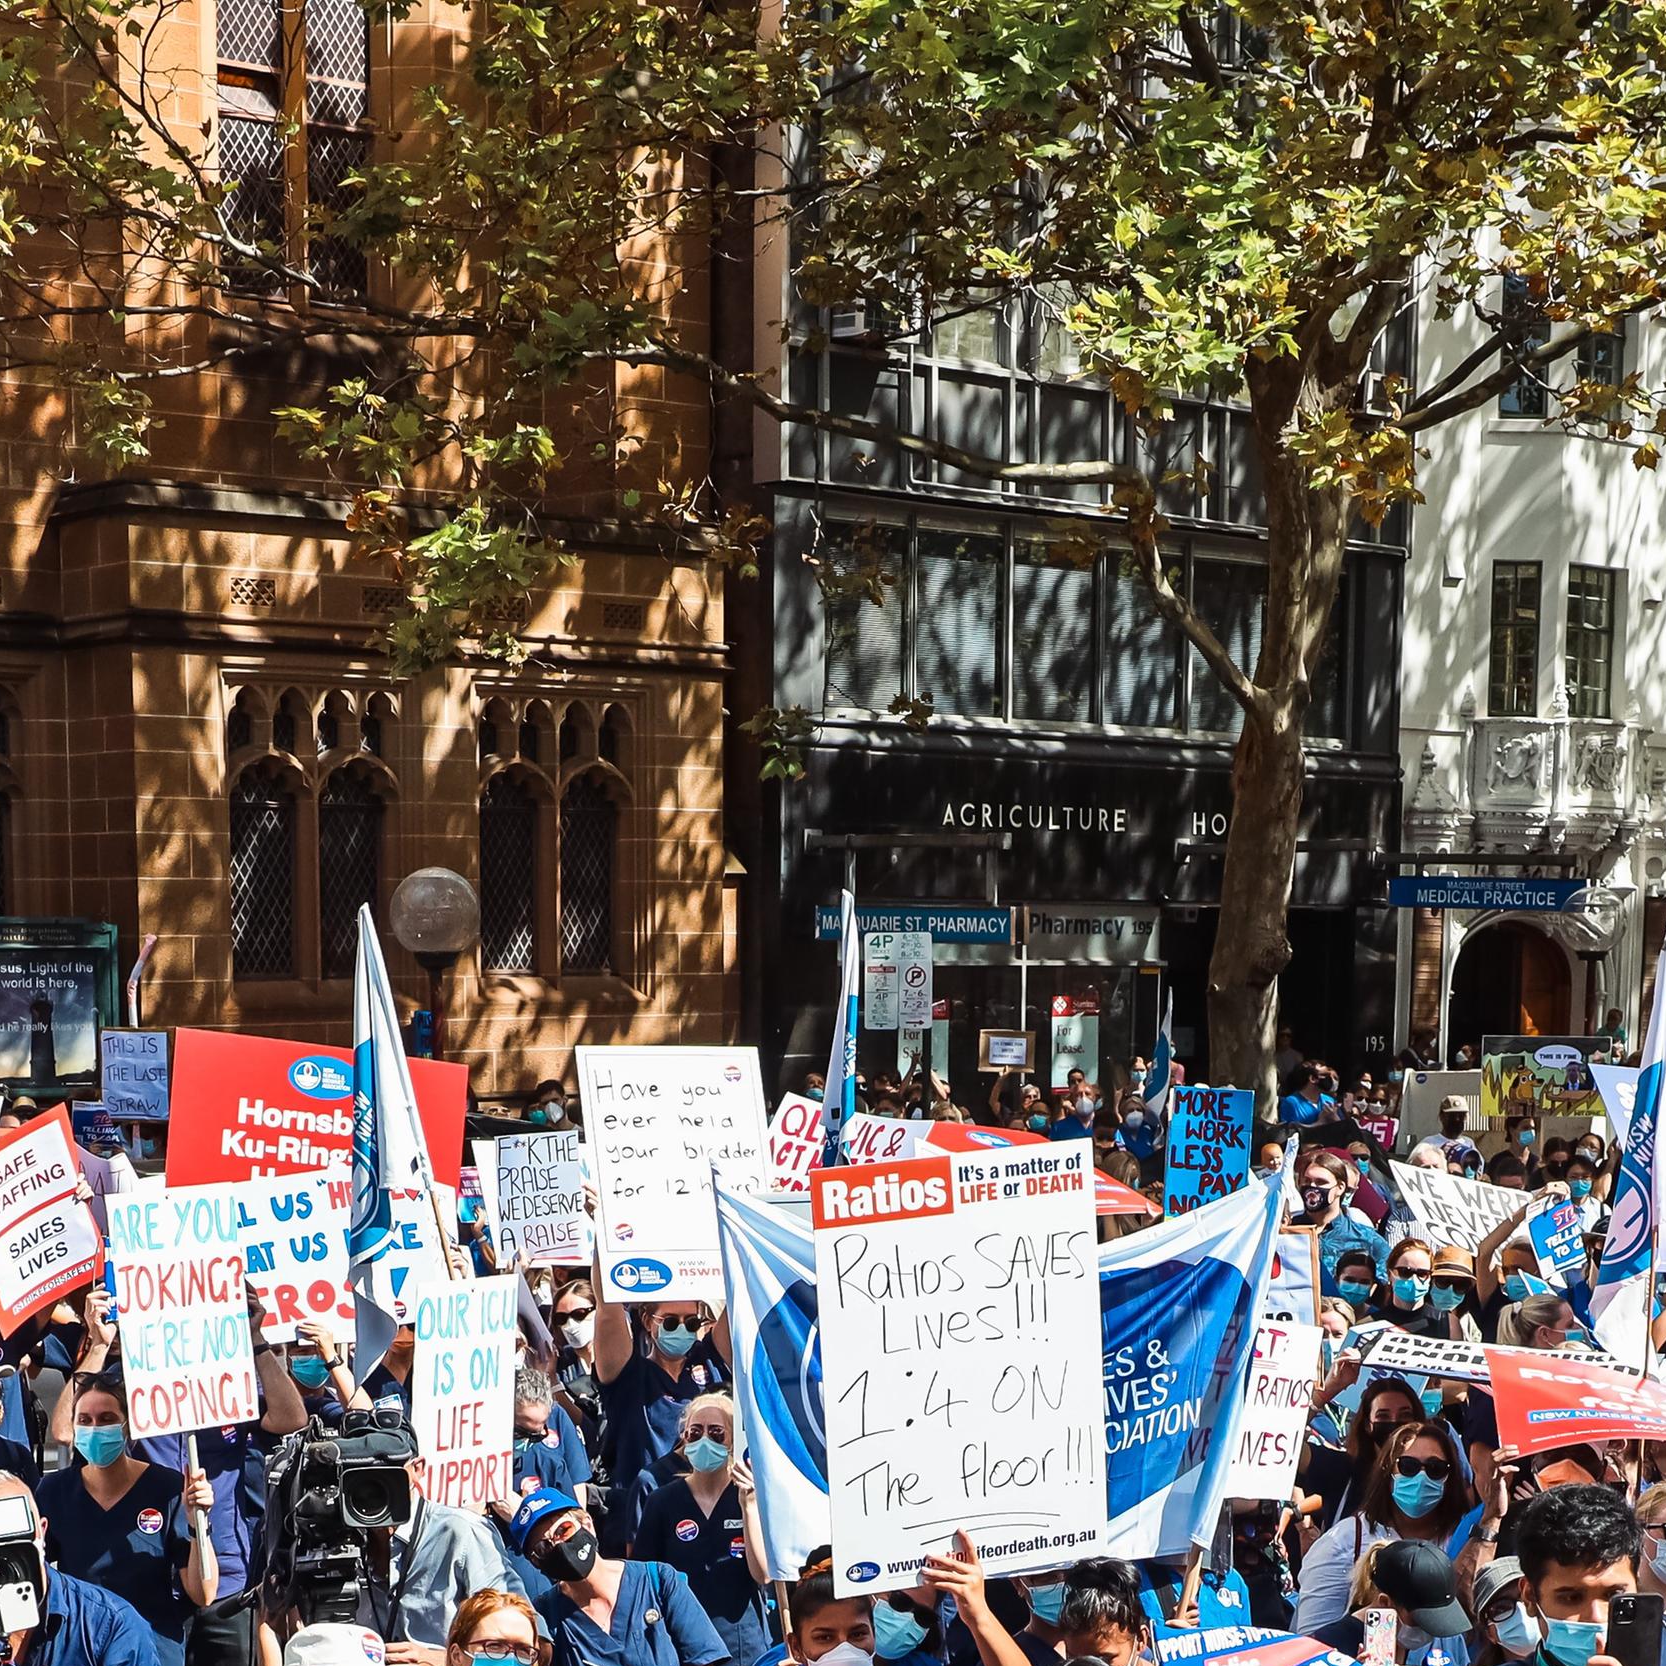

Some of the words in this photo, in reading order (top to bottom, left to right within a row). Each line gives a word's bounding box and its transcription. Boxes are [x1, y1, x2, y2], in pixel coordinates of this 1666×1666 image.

[942, 802, 1126, 833] AGRICULTURE
[1417, 889, 1479, 904] MEDICAL
[1484, 890, 1555, 906] PRACTICE
[822, 914, 901, 932] MAQUARIE
[905, 916, 924, 932] ST.
[928, 916, 1007, 933] PHARMACY
[1031, 913, 1125, 938] Pharmacy
[1132, 921, 1152, 935] 195
[869, 935, 894, 949] 4P
[29, 962, 57, 975] Light
[75, 963, 93, 973] the
[1, 977, 32, 988] world
[49, 977, 78, 990] here,
[1056, 1025, 1072, 1036] For
[1365, 1036, 1385, 1052] 195
[104, 1037, 133, 1053] THIS
[106, 1065, 128, 1081] THE
[134, 1063, 165, 1081] LAST
[594, 1070, 661, 1103] Have
[682, 1085, 721, 1105] you
[106, 1097, 161, 1113] STRAW
[1174, 1091, 1234, 1124] MORE
[604, 1114, 656, 1129] ever
[679, 1114, 733, 1128] held
[1186, 1119, 1245, 1149] WORK
[541, 1135, 578, 1162] THE
[606, 1145, 659, 1163] your
[1171, 1144, 1223, 1172] LESS
[498, 1165, 559, 1196] PRAISE
[959, 1165, 983, 1182] It's
[1005, 1157, 1060, 1177] matter
[613, 1178, 644, 1198] for
[822, 1172, 947, 1220] Ratios
[960, 1182, 997, 1203] LIFE
[1025, 1172, 1083, 1196] DEATH
[1199, 1173, 1243, 1197] PAY
[524, 1192, 582, 1219] DESERVE
[10, 1217, 65, 1258] SAVES
[112, 1196, 163, 1254] ARE
[174, 1195, 235, 1243] YOU
[523, 1220, 581, 1248] RAISE
[20, 1241, 68, 1280] LIVES
[834, 1233, 964, 1308] Ratios
[975, 1231, 1089, 1288] SAVES
[118, 1257, 243, 1314] JOKING?
[417, 1291, 469, 1341] OUR
[481, 1287, 517, 1332] ICU
[202, 1310, 249, 1362] NOT
[132, 1371, 254, 1433] COPING!
[839, 1371, 968, 1448] 1:4
[992, 1360, 1067, 1420] ON
[1255, 1379, 1312, 1408] RATIOS
[437, 1402, 483, 1451] LIFE
[846, 1461, 933, 1516] The
